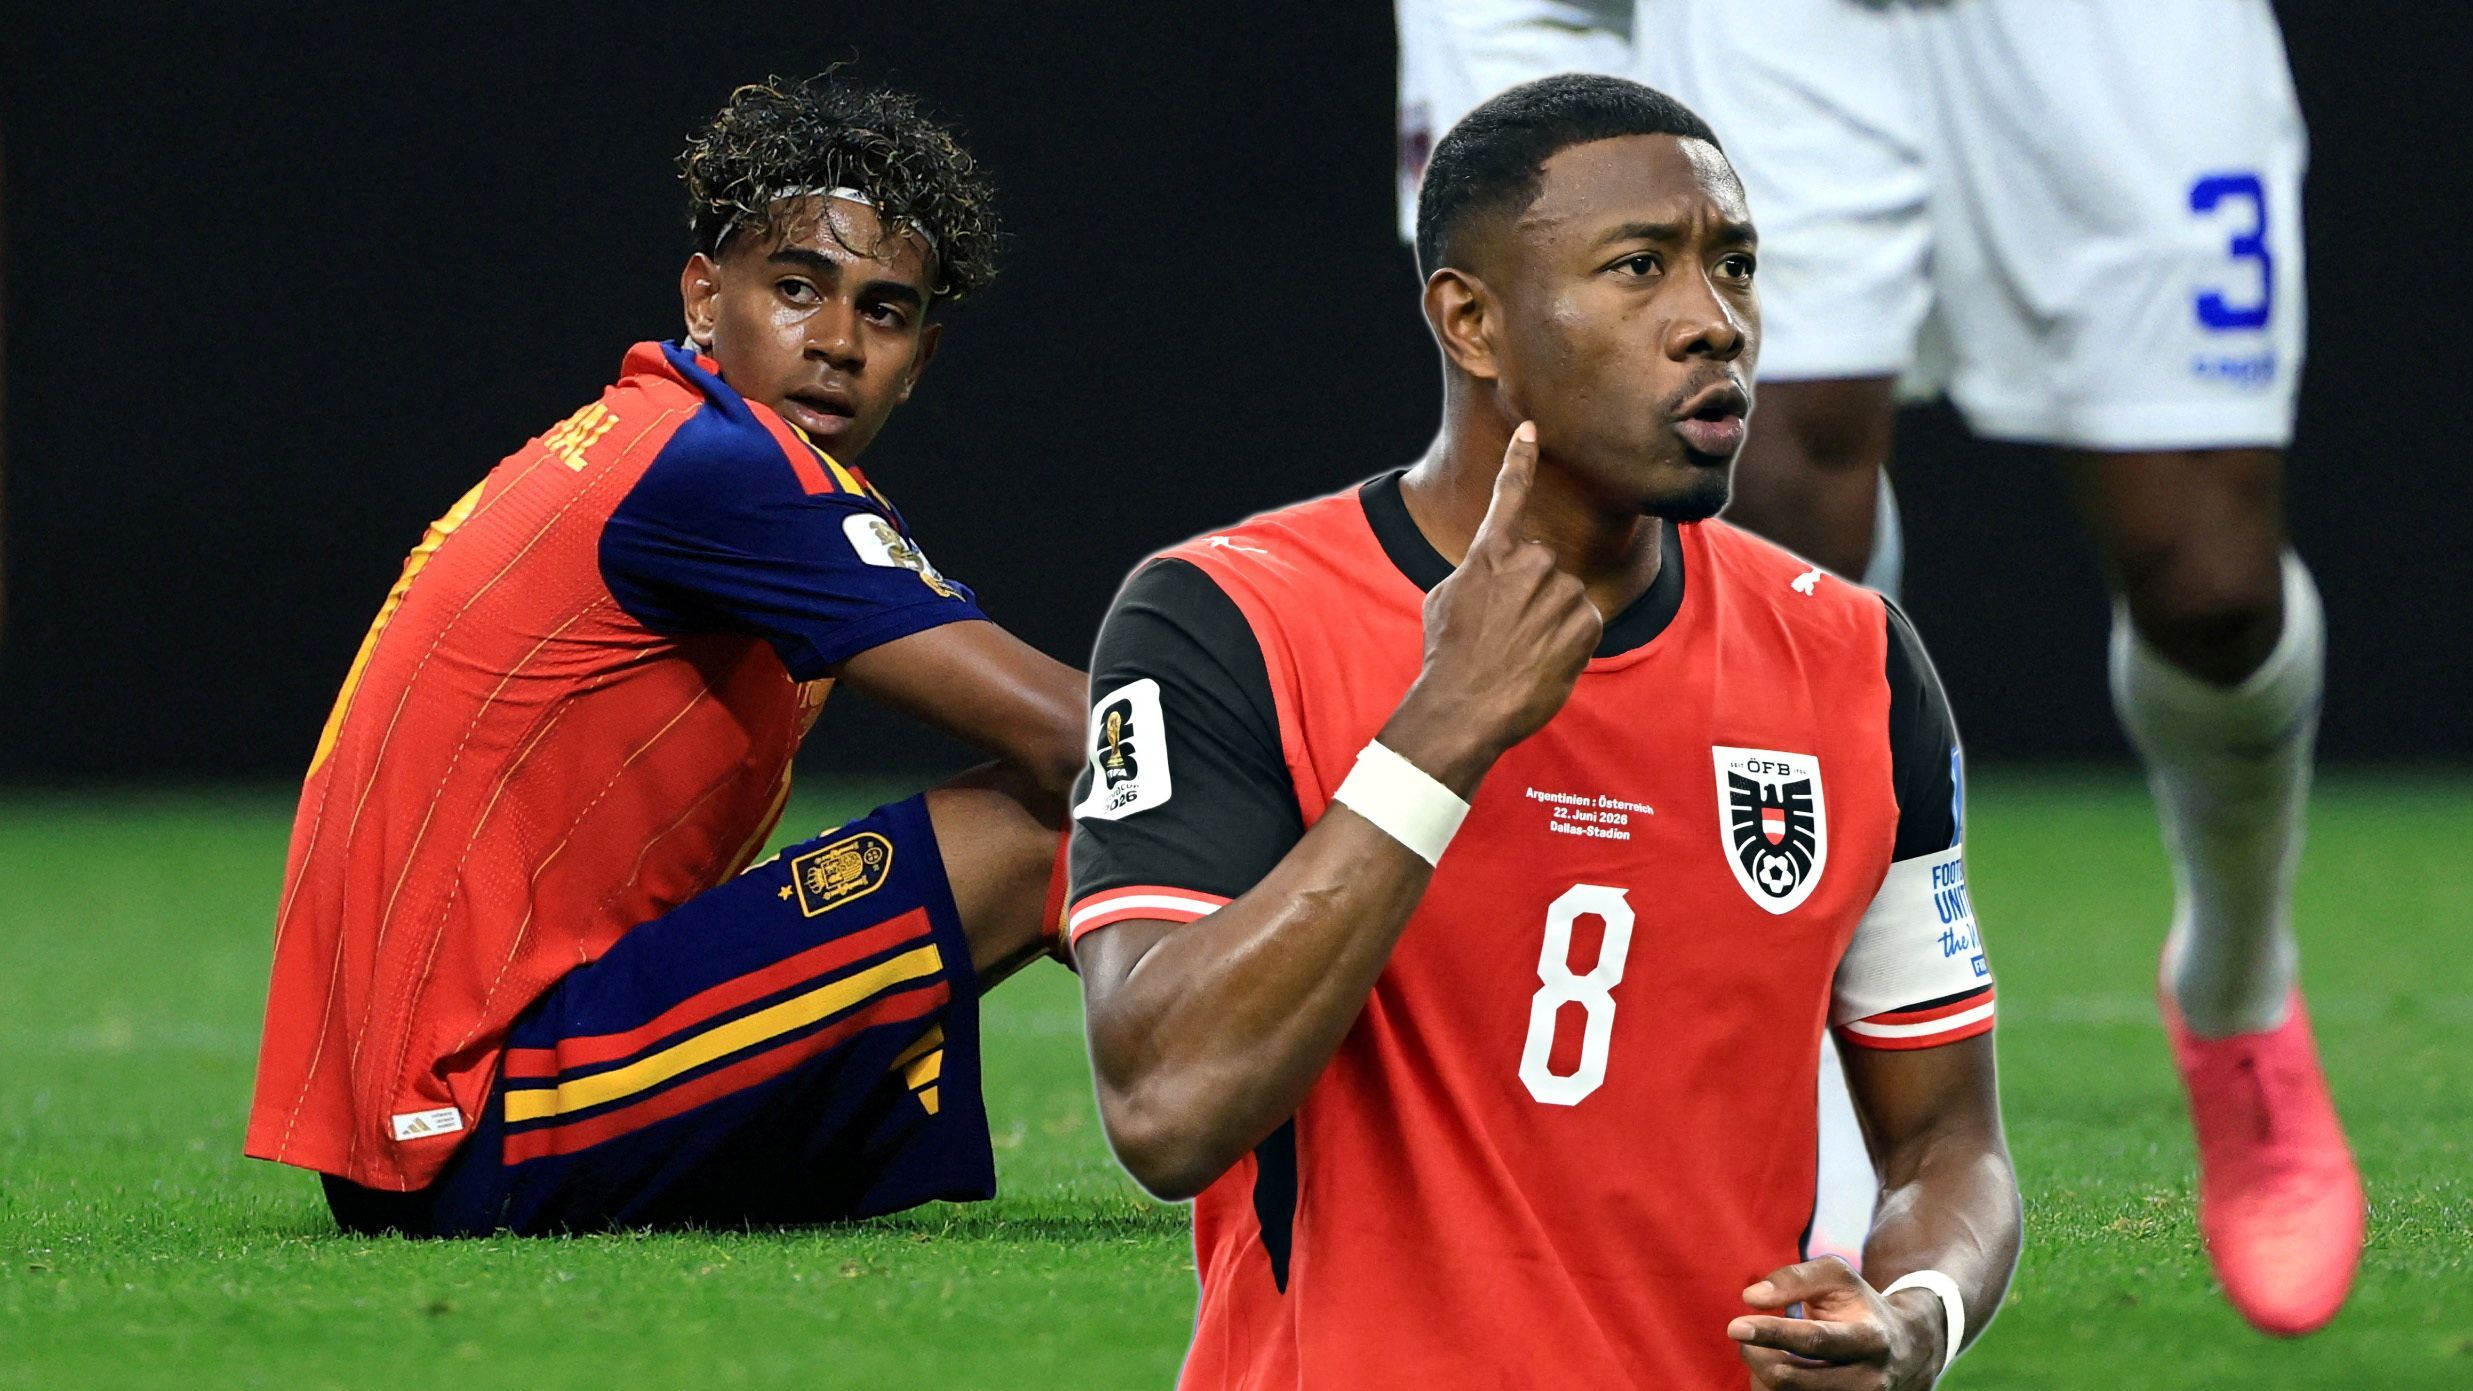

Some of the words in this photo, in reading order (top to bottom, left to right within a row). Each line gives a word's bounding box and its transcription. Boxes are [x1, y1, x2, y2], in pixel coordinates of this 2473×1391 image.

[2189, 175, 2272, 330] 3
[1747, 757, 1791, 776] ÖFB
[1526, 787, 1590, 807] Argentinien
[1598, 794, 1655, 816] Österreich
[1553, 806, 1571, 820] 22.
[1572, 809, 1597, 823] Juni
[1599, 812, 1628, 826] 2026
[1550, 820, 1631, 841] Dallas-Stadion
[1937, 926, 1970, 958] the
[1518, 883, 1636, 1107] 8
